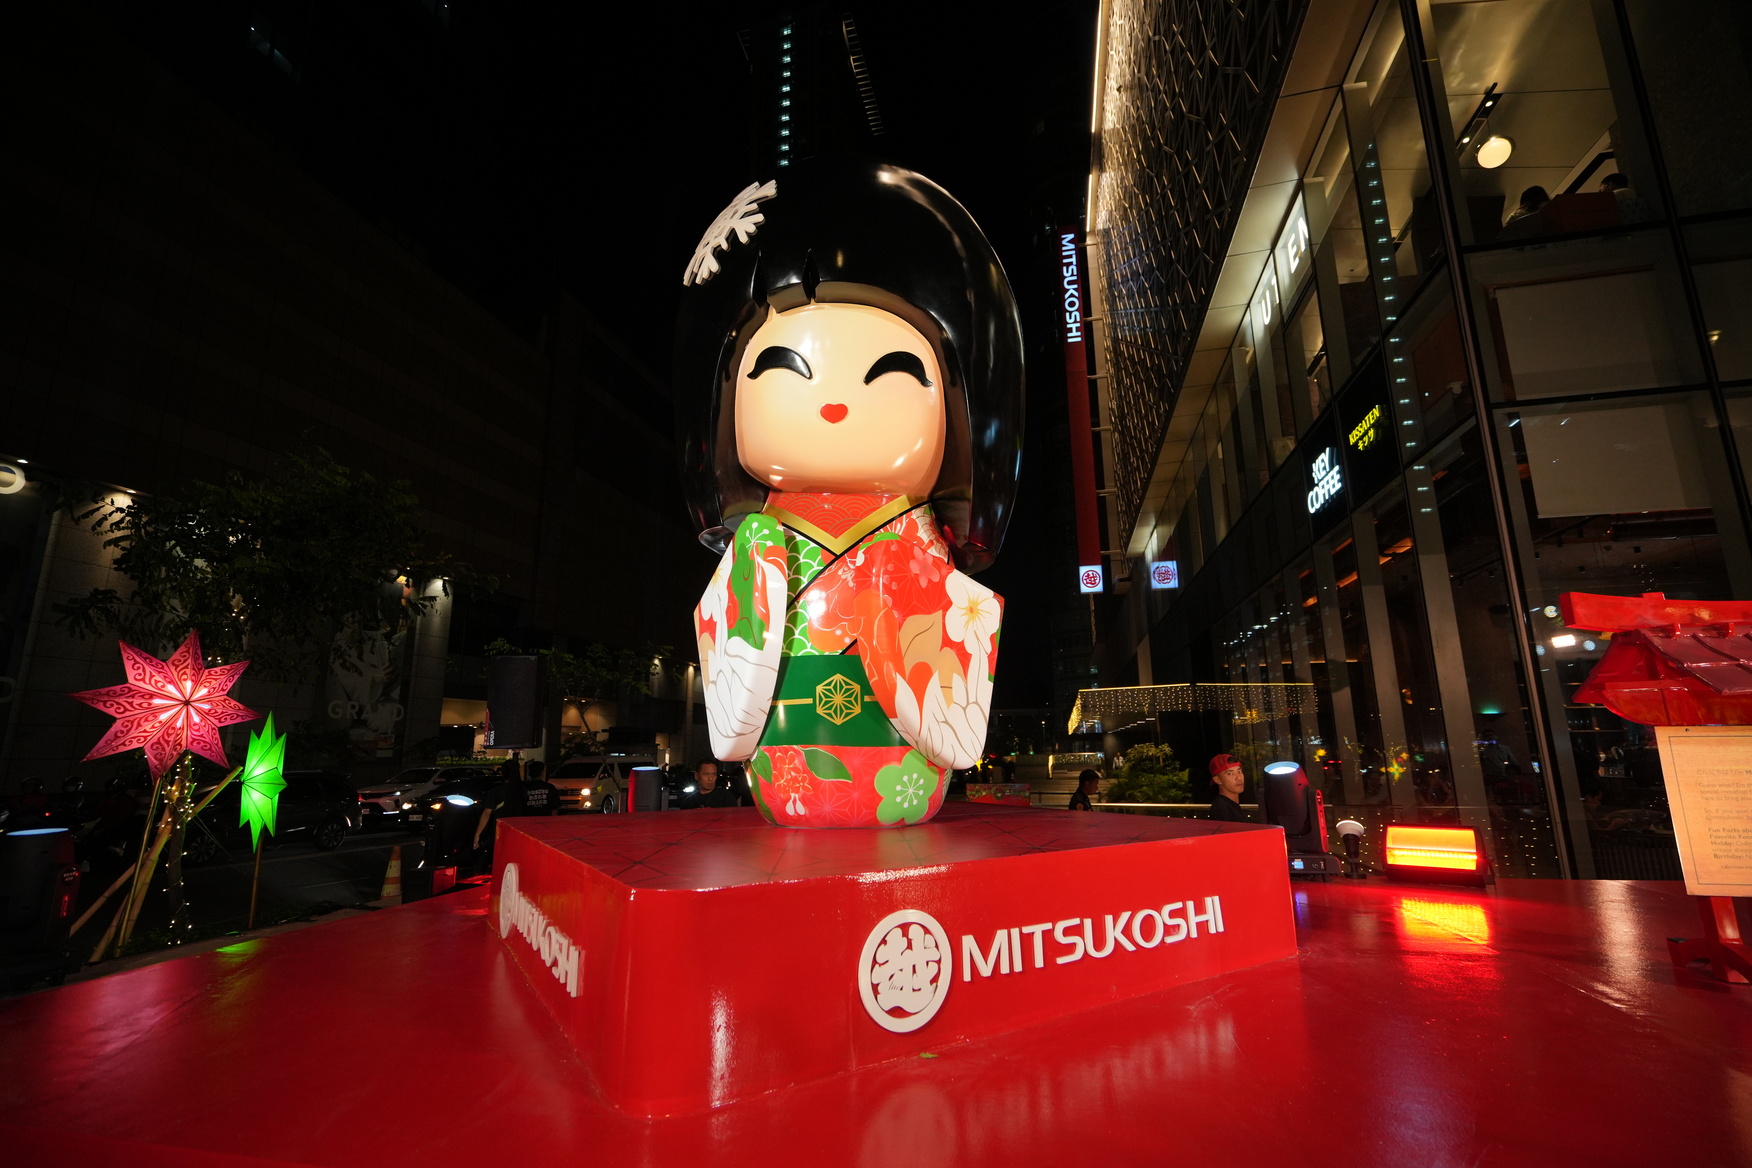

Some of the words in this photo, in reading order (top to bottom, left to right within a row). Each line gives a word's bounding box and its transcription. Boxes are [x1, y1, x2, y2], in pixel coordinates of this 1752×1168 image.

[1061, 233, 1082, 343] MITSUKOSHI
[1348, 404, 1380, 446] KISSATEN
[1312, 446, 1330, 484] KEY
[1307, 464, 1342, 514] COFFEE
[1713, 853, 1744, 861] Birthday:
[960, 895, 1225, 983] MITSUKOSHI
